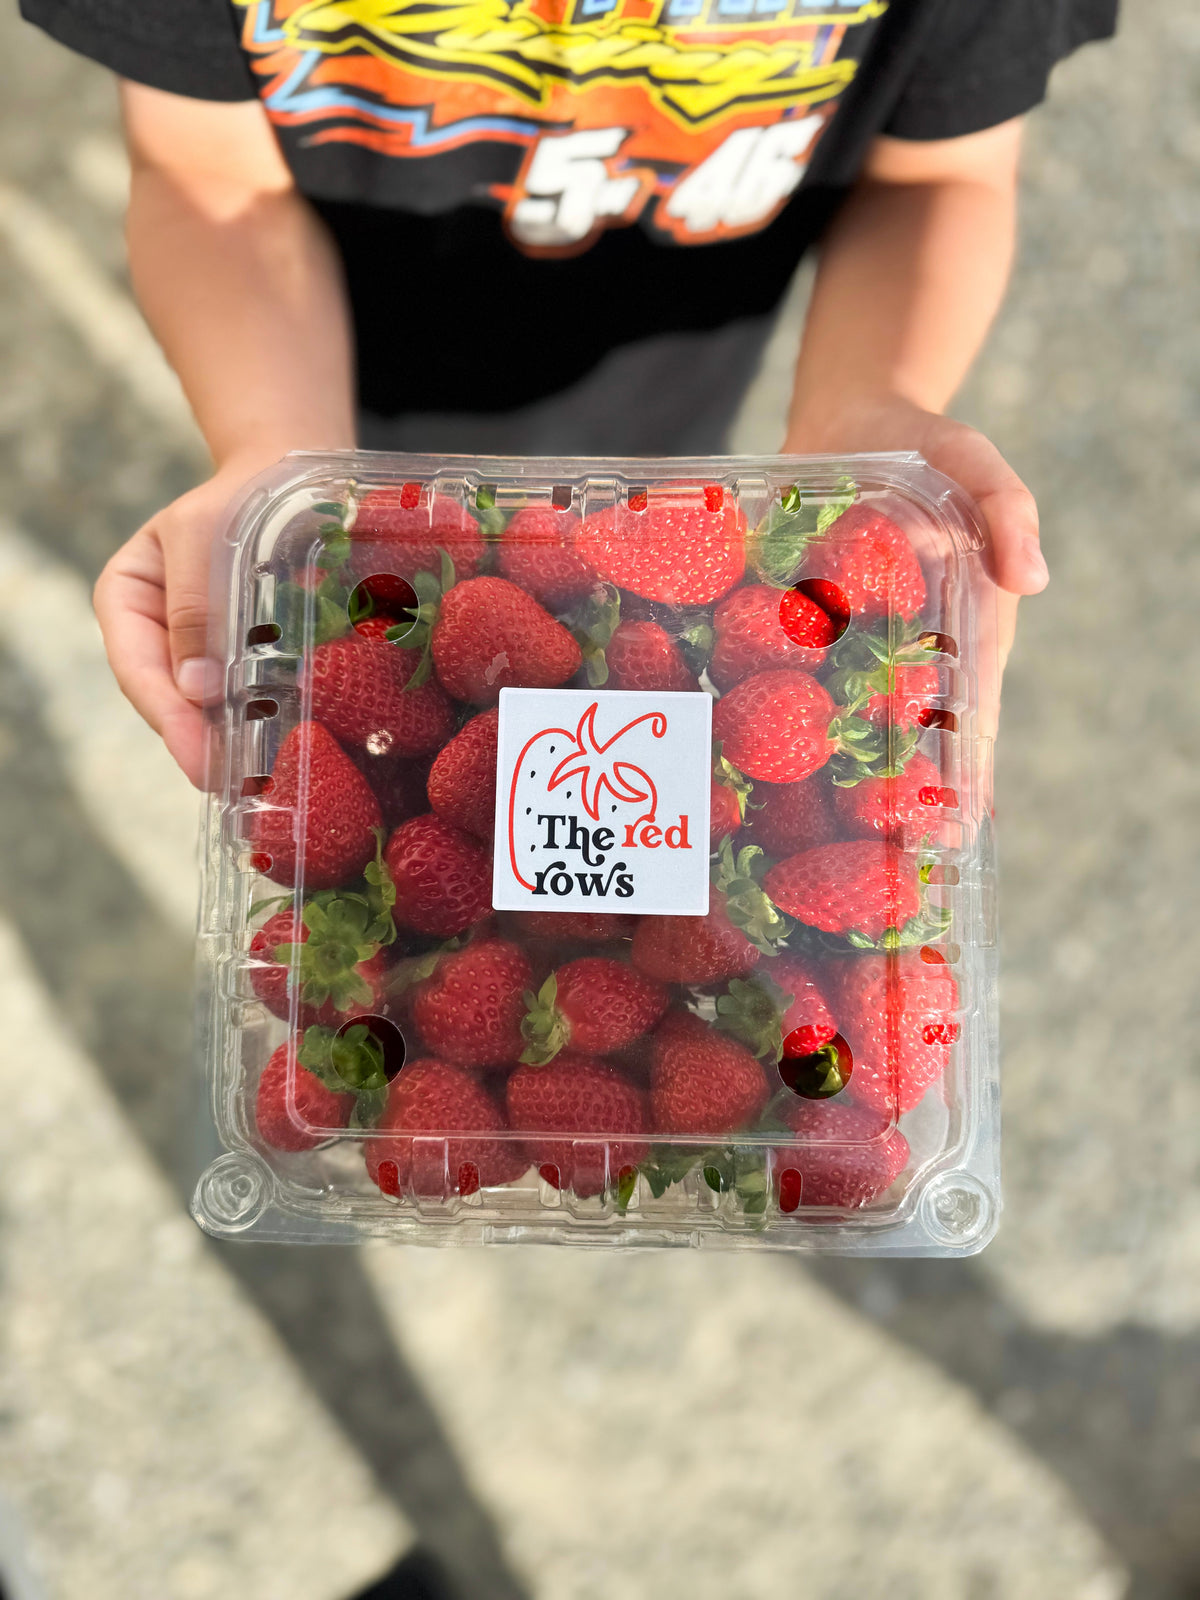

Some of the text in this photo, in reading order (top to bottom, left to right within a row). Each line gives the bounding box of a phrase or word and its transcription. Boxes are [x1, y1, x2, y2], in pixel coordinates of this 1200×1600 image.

[537, 814, 693, 867] The red
[531, 861, 635, 898] rows
